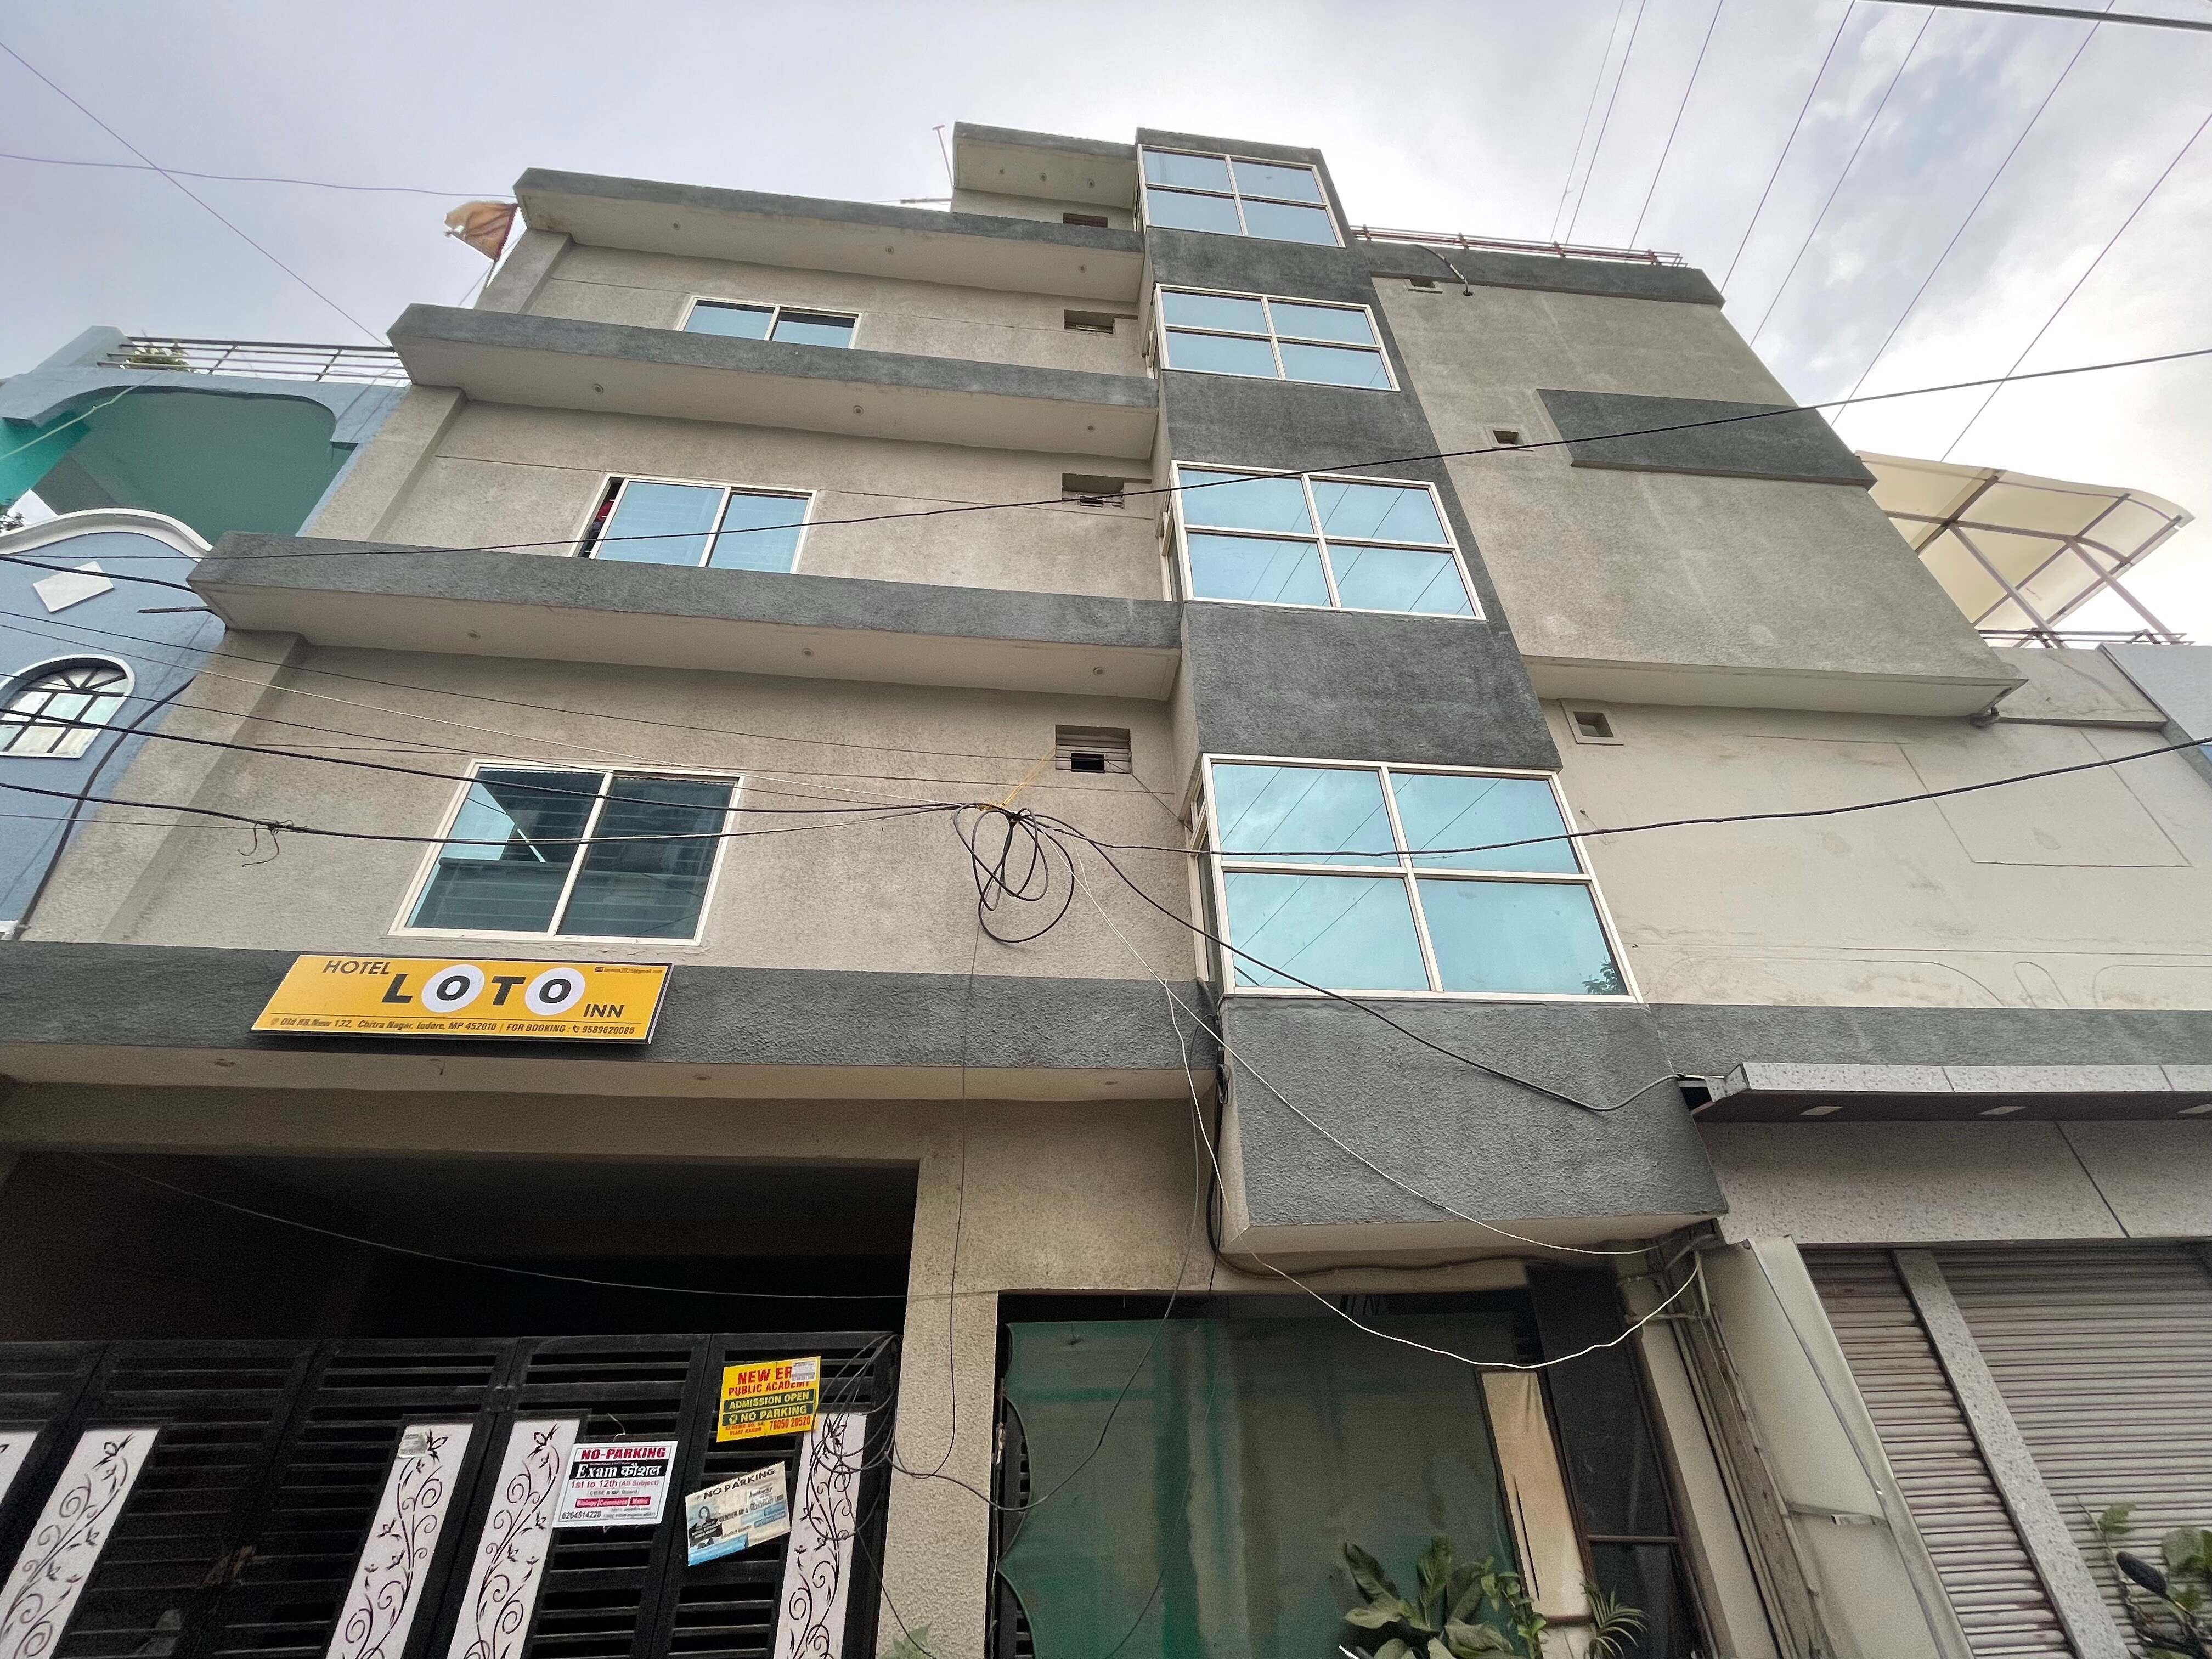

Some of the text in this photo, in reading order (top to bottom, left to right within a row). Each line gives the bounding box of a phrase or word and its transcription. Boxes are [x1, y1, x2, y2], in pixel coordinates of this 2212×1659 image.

[323, 960, 390, 975] HOTEL
[381, 973, 572, 1006] LOTO
[583, 1003, 624, 1018] INN
[280, 1018, 297, 1026] Old
[358, 1020, 385, 1029] Chitra
[448, 1022, 464, 1030] MP
[465, 1022, 498, 1030] 452010
[506, 1023, 524, 1031] FOR
[582, 1025, 635, 1034] 9589620086
[737, 1369, 771, 1385] NEW
[776, 1366, 792, 1380] ER
[729, 1384, 763, 1396] PUBLIC
[729, 1391, 809, 1410] ADMISSION OPEN
[741, 1405, 807, 1423] NO PARKING
[769, 1415, 811, 1431] 78050 20520
[581, 1447, 666, 1460] NO-PARKING
[576, 1463, 662, 1478] Exam कौशल
[571, 1480, 584, 1489] 1st
[587, 1480, 596, 1488] to
[600, 1479, 618, 1488] 12th
[703, 1488, 723, 1499] NO
[724, 1468, 775, 1492] PARKING
